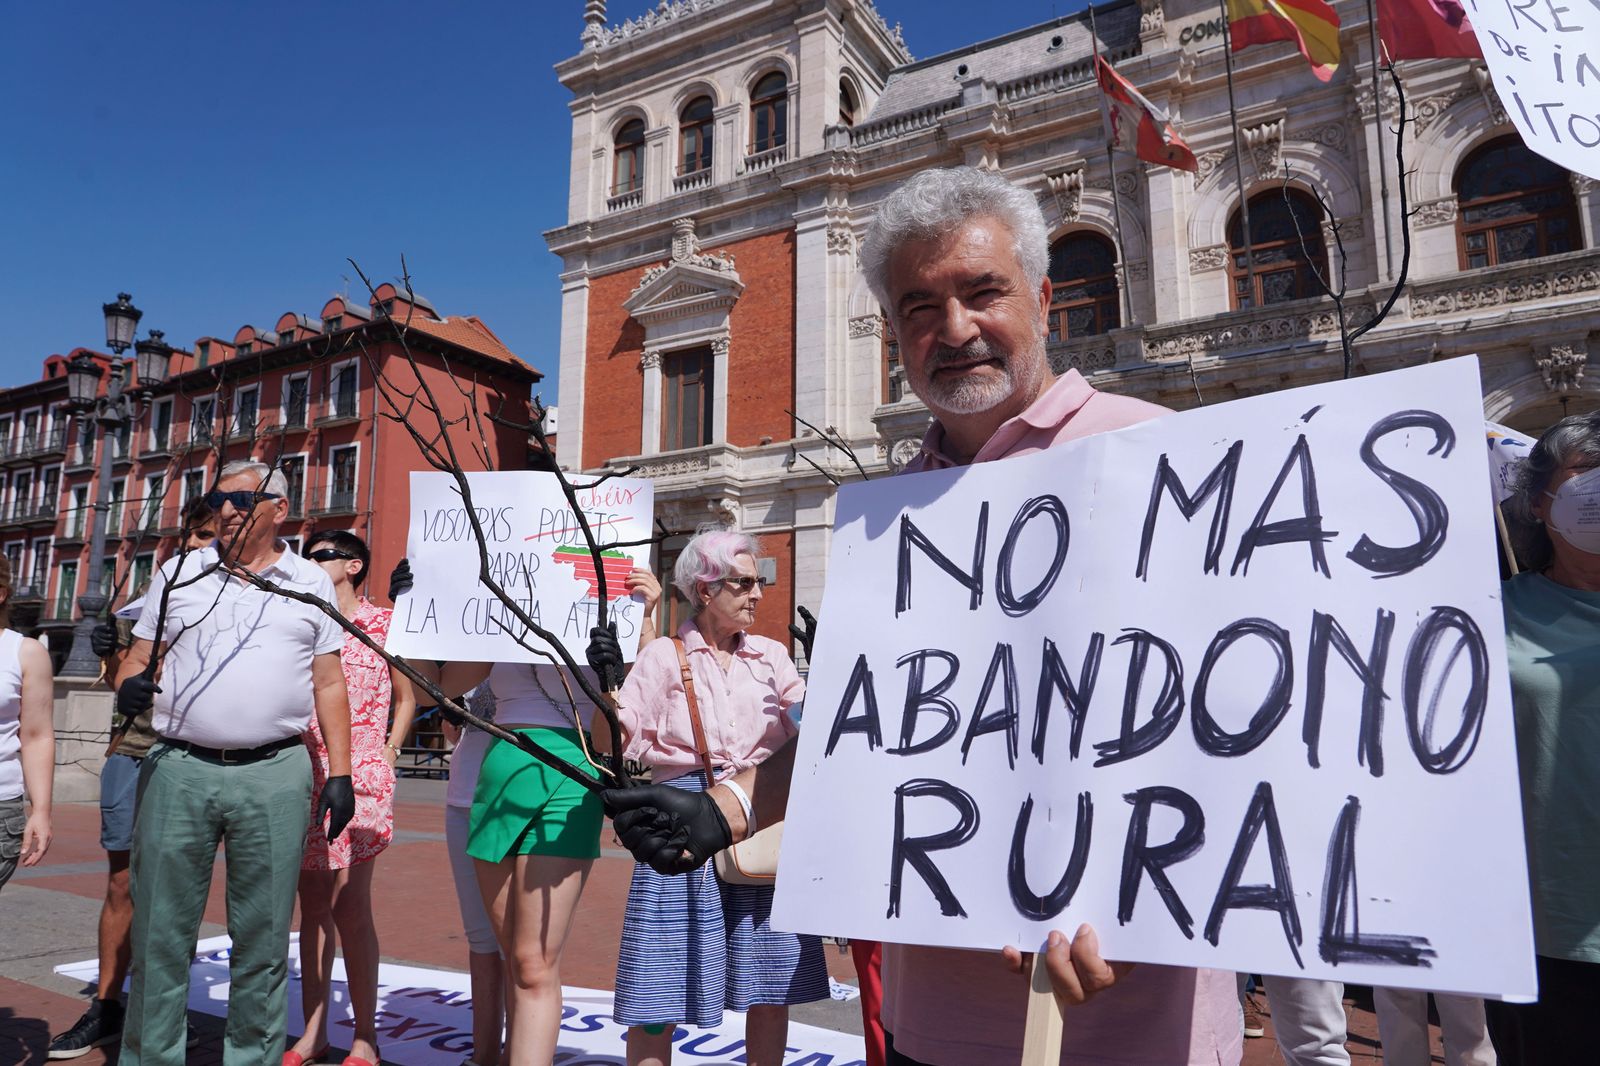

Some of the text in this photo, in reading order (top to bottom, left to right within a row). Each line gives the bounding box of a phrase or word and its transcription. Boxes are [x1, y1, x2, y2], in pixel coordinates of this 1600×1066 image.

[1488, 30, 1532, 62] DE
[896, 404, 1456, 618] NO MÁS
[405, 597, 636, 639] LA CUENTA ATÁS
[477, 552, 541, 588] PARAR
[825, 605, 1489, 777] ABANDONO
[886, 778, 1437, 970] RURAL
